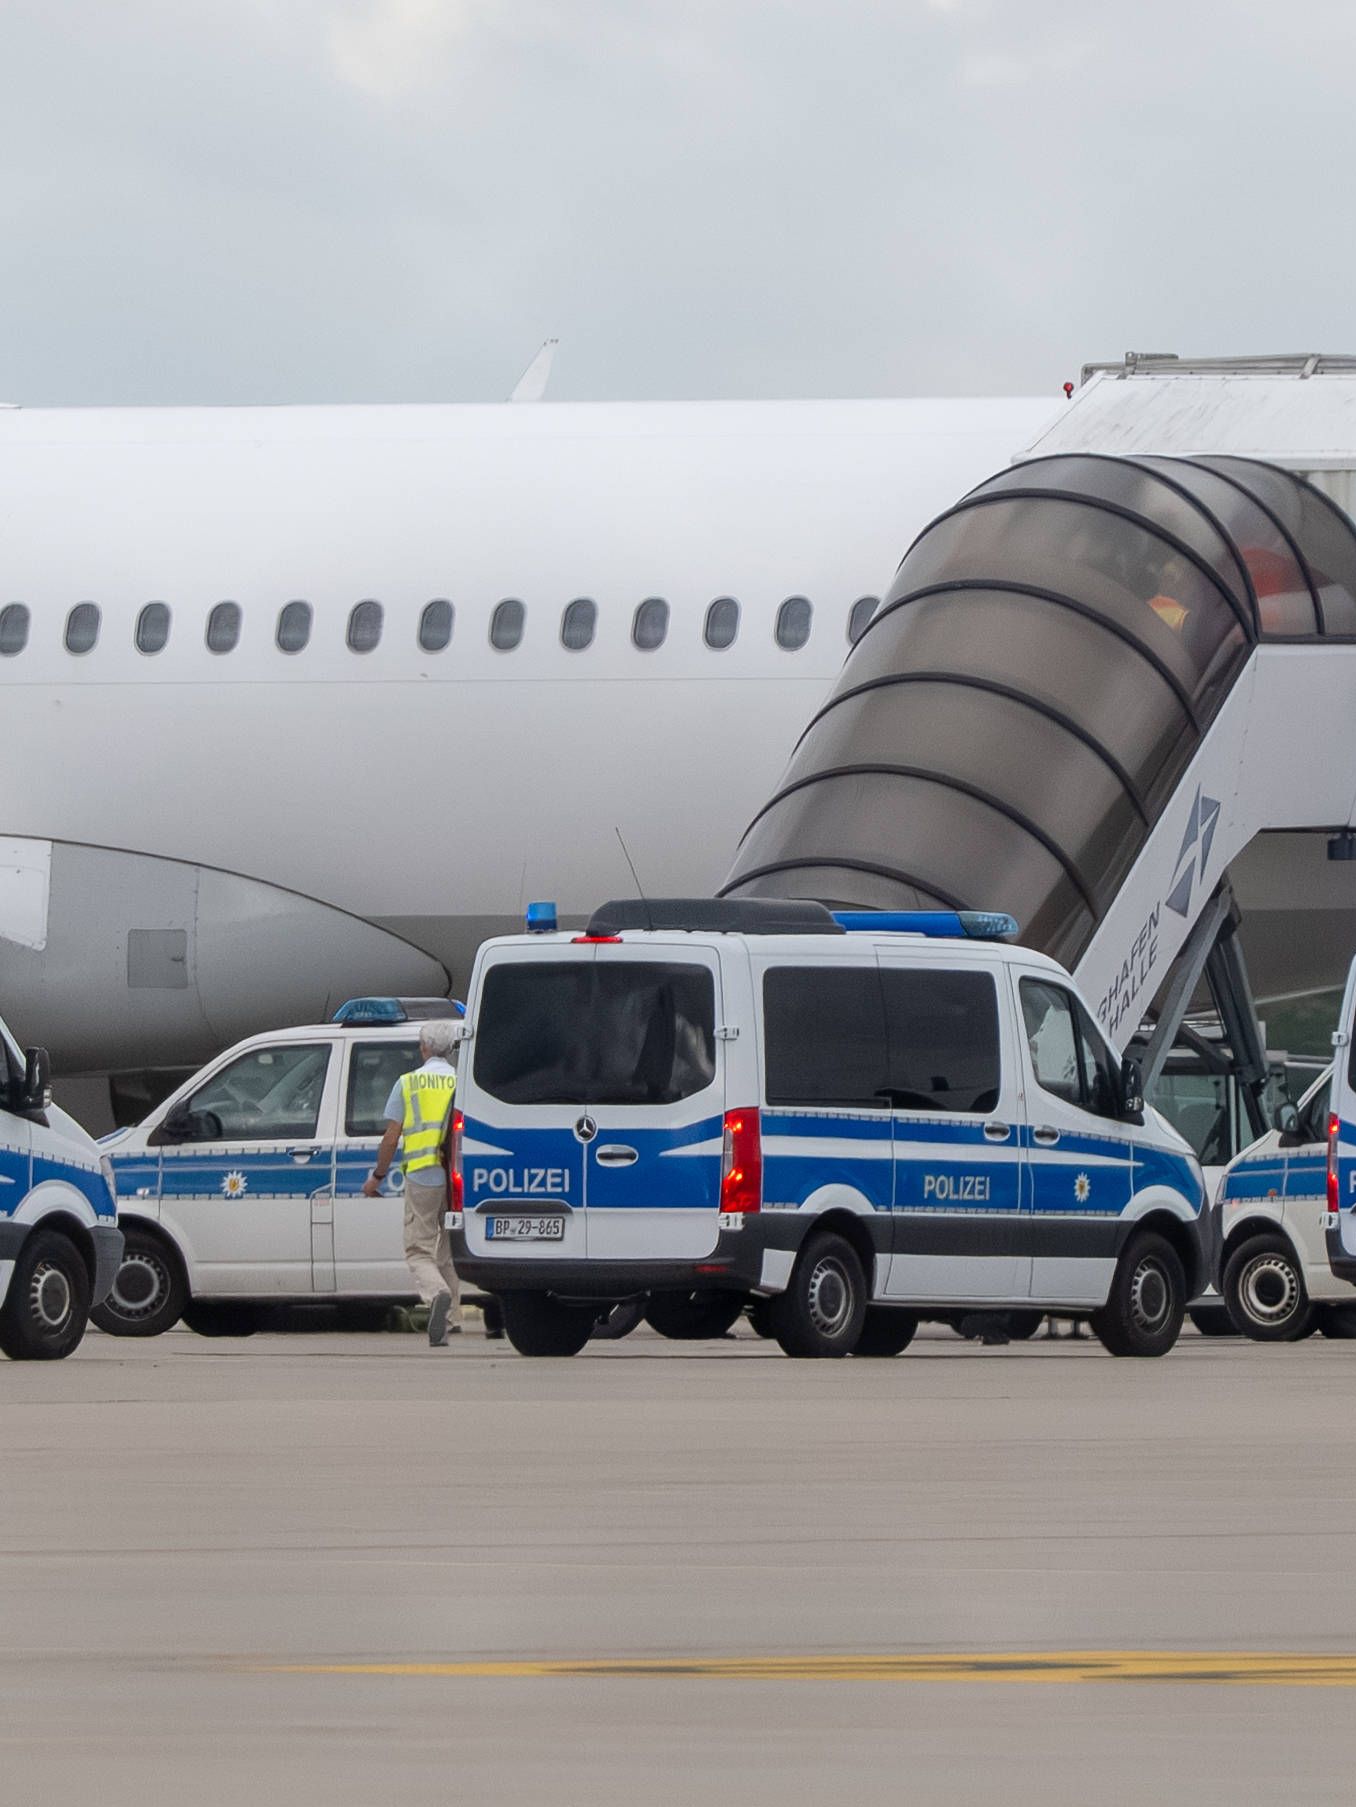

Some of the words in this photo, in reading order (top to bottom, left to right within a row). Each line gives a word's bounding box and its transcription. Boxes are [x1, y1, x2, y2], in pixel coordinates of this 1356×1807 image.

[1108, 934, 1159, 1039] HALLE
[472, 1168, 570, 1193] POLIZEI
[923, 1174, 991, 1201] POLIZEI
[495, 1220, 510, 1235] BP
[518, 1220, 560, 1235] 29-865
